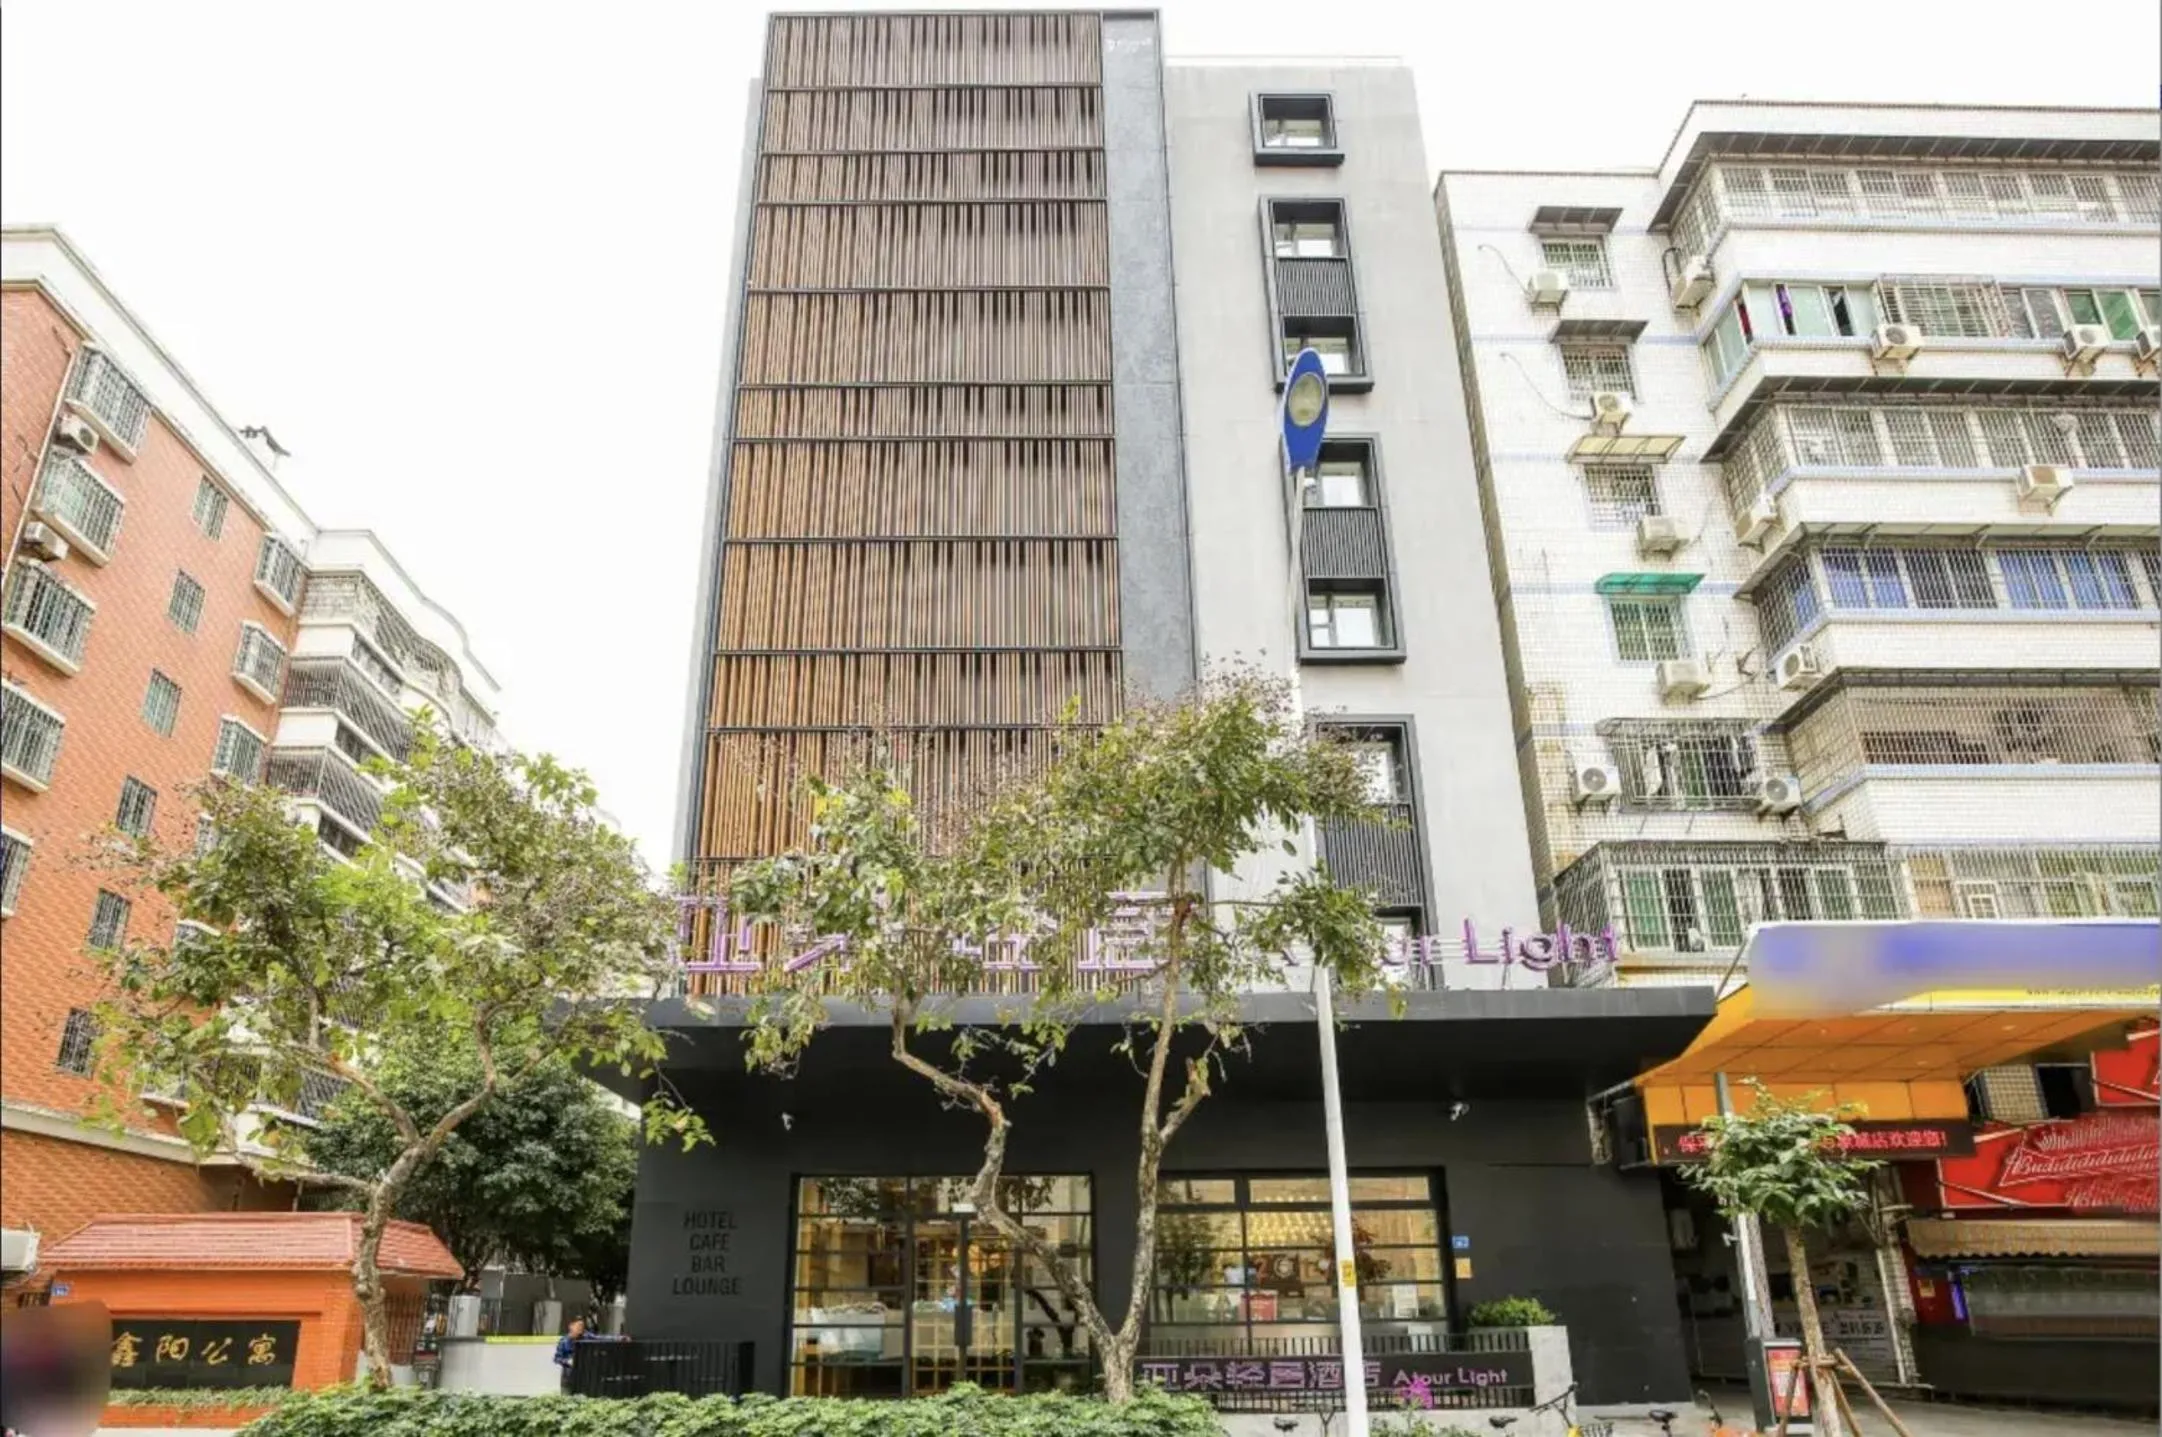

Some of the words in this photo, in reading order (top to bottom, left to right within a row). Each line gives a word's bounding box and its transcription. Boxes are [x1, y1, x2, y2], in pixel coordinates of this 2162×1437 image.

[1463, 917, 1617, 972] Light
[683, 1211, 738, 1230] HOTEL
[689, 1233, 730, 1251] CAFE
[691, 1255, 726, 1273] BAR
[672, 1277, 742, 1296] LOUNGE
[1456, 1366, 1508, 1387] Light
